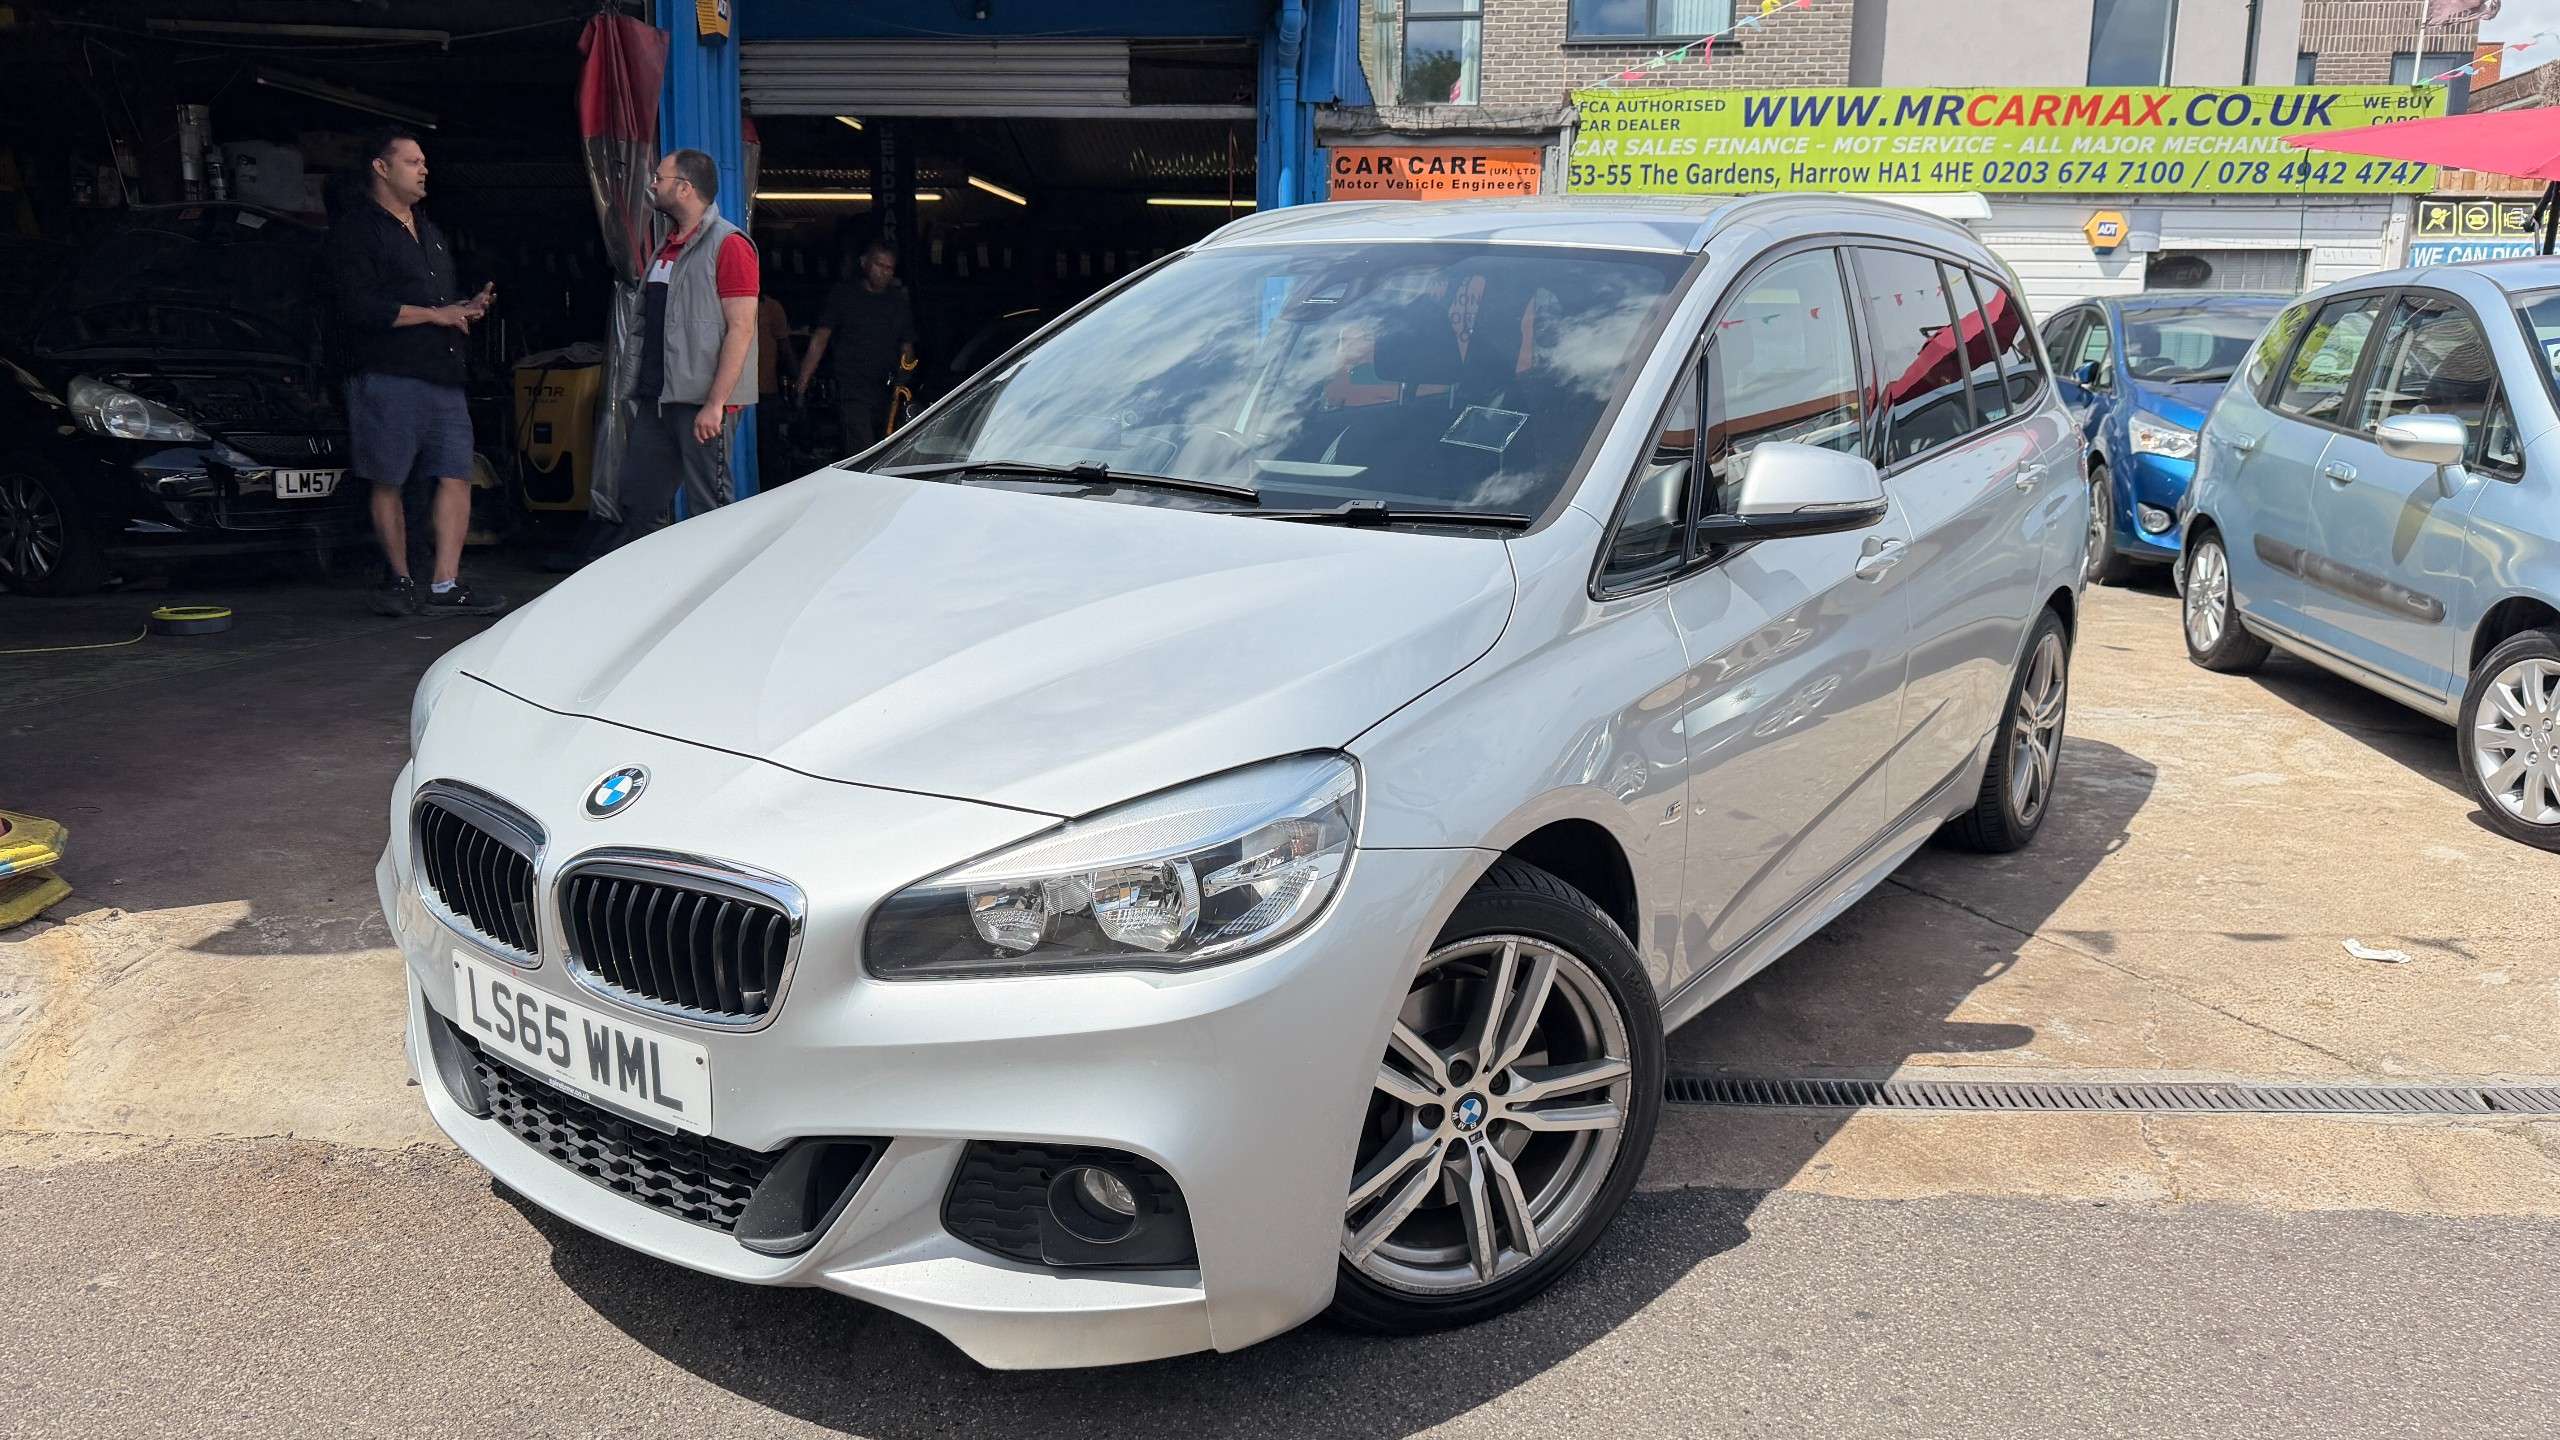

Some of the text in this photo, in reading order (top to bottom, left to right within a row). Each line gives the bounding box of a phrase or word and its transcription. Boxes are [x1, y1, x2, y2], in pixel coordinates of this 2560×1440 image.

[1579, 100, 1726, 113] FCA AUTHORISED
[1744, 93, 2341, 128] WWW.MRCARMAX.CO.UK
[2363, 96, 2434, 109] WE BUY
[1579, 119, 1680, 132] CAR DEALER
[1574, 138, 1618, 156] CAR
[1625, 137, 1697, 155] SALES
[1703, 137, 1809, 155] FINANCE
[1832, 136, 1888, 154] MOT
[1891, 136, 1997, 154] SERVICE
[2018, 136, 2063, 154] ALL
[2070, 136, 2156, 154] MAJOR
[1335, 156, 1393, 175] CAR
[1408, 156, 1487, 175] CARE
[1489, 167, 1513, 176] (UK)
[1571, 164, 1632, 186] 53-55
[1640, 163, 1678, 185] The
[1686, 162, 1780, 188] Gardens,
[1790, 162, 1871, 183] Harrow
[1878, 162, 1921, 183] HA1
[1931, 161, 1974, 183] 4HE
[1983, 161, 2049, 184] 0203
[2058, 161, 2108, 184] 674
[2117, 161, 2184, 184] 7100
[2218, 161, 2270, 184] 078
[2278, 161, 2347, 184] 4942
[2355, 161, 2428, 184] 4747
[1334, 178, 1532, 192] Motor Vehicle Engineers
[2097, 223, 2119, 236] ADT
[2413, 247, 2445, 268] WE
[2447, 246, 2489, 264] CAN
[285, 472, 335, 494] LM57
[467, 966, 684, 1112] LS65 WML
